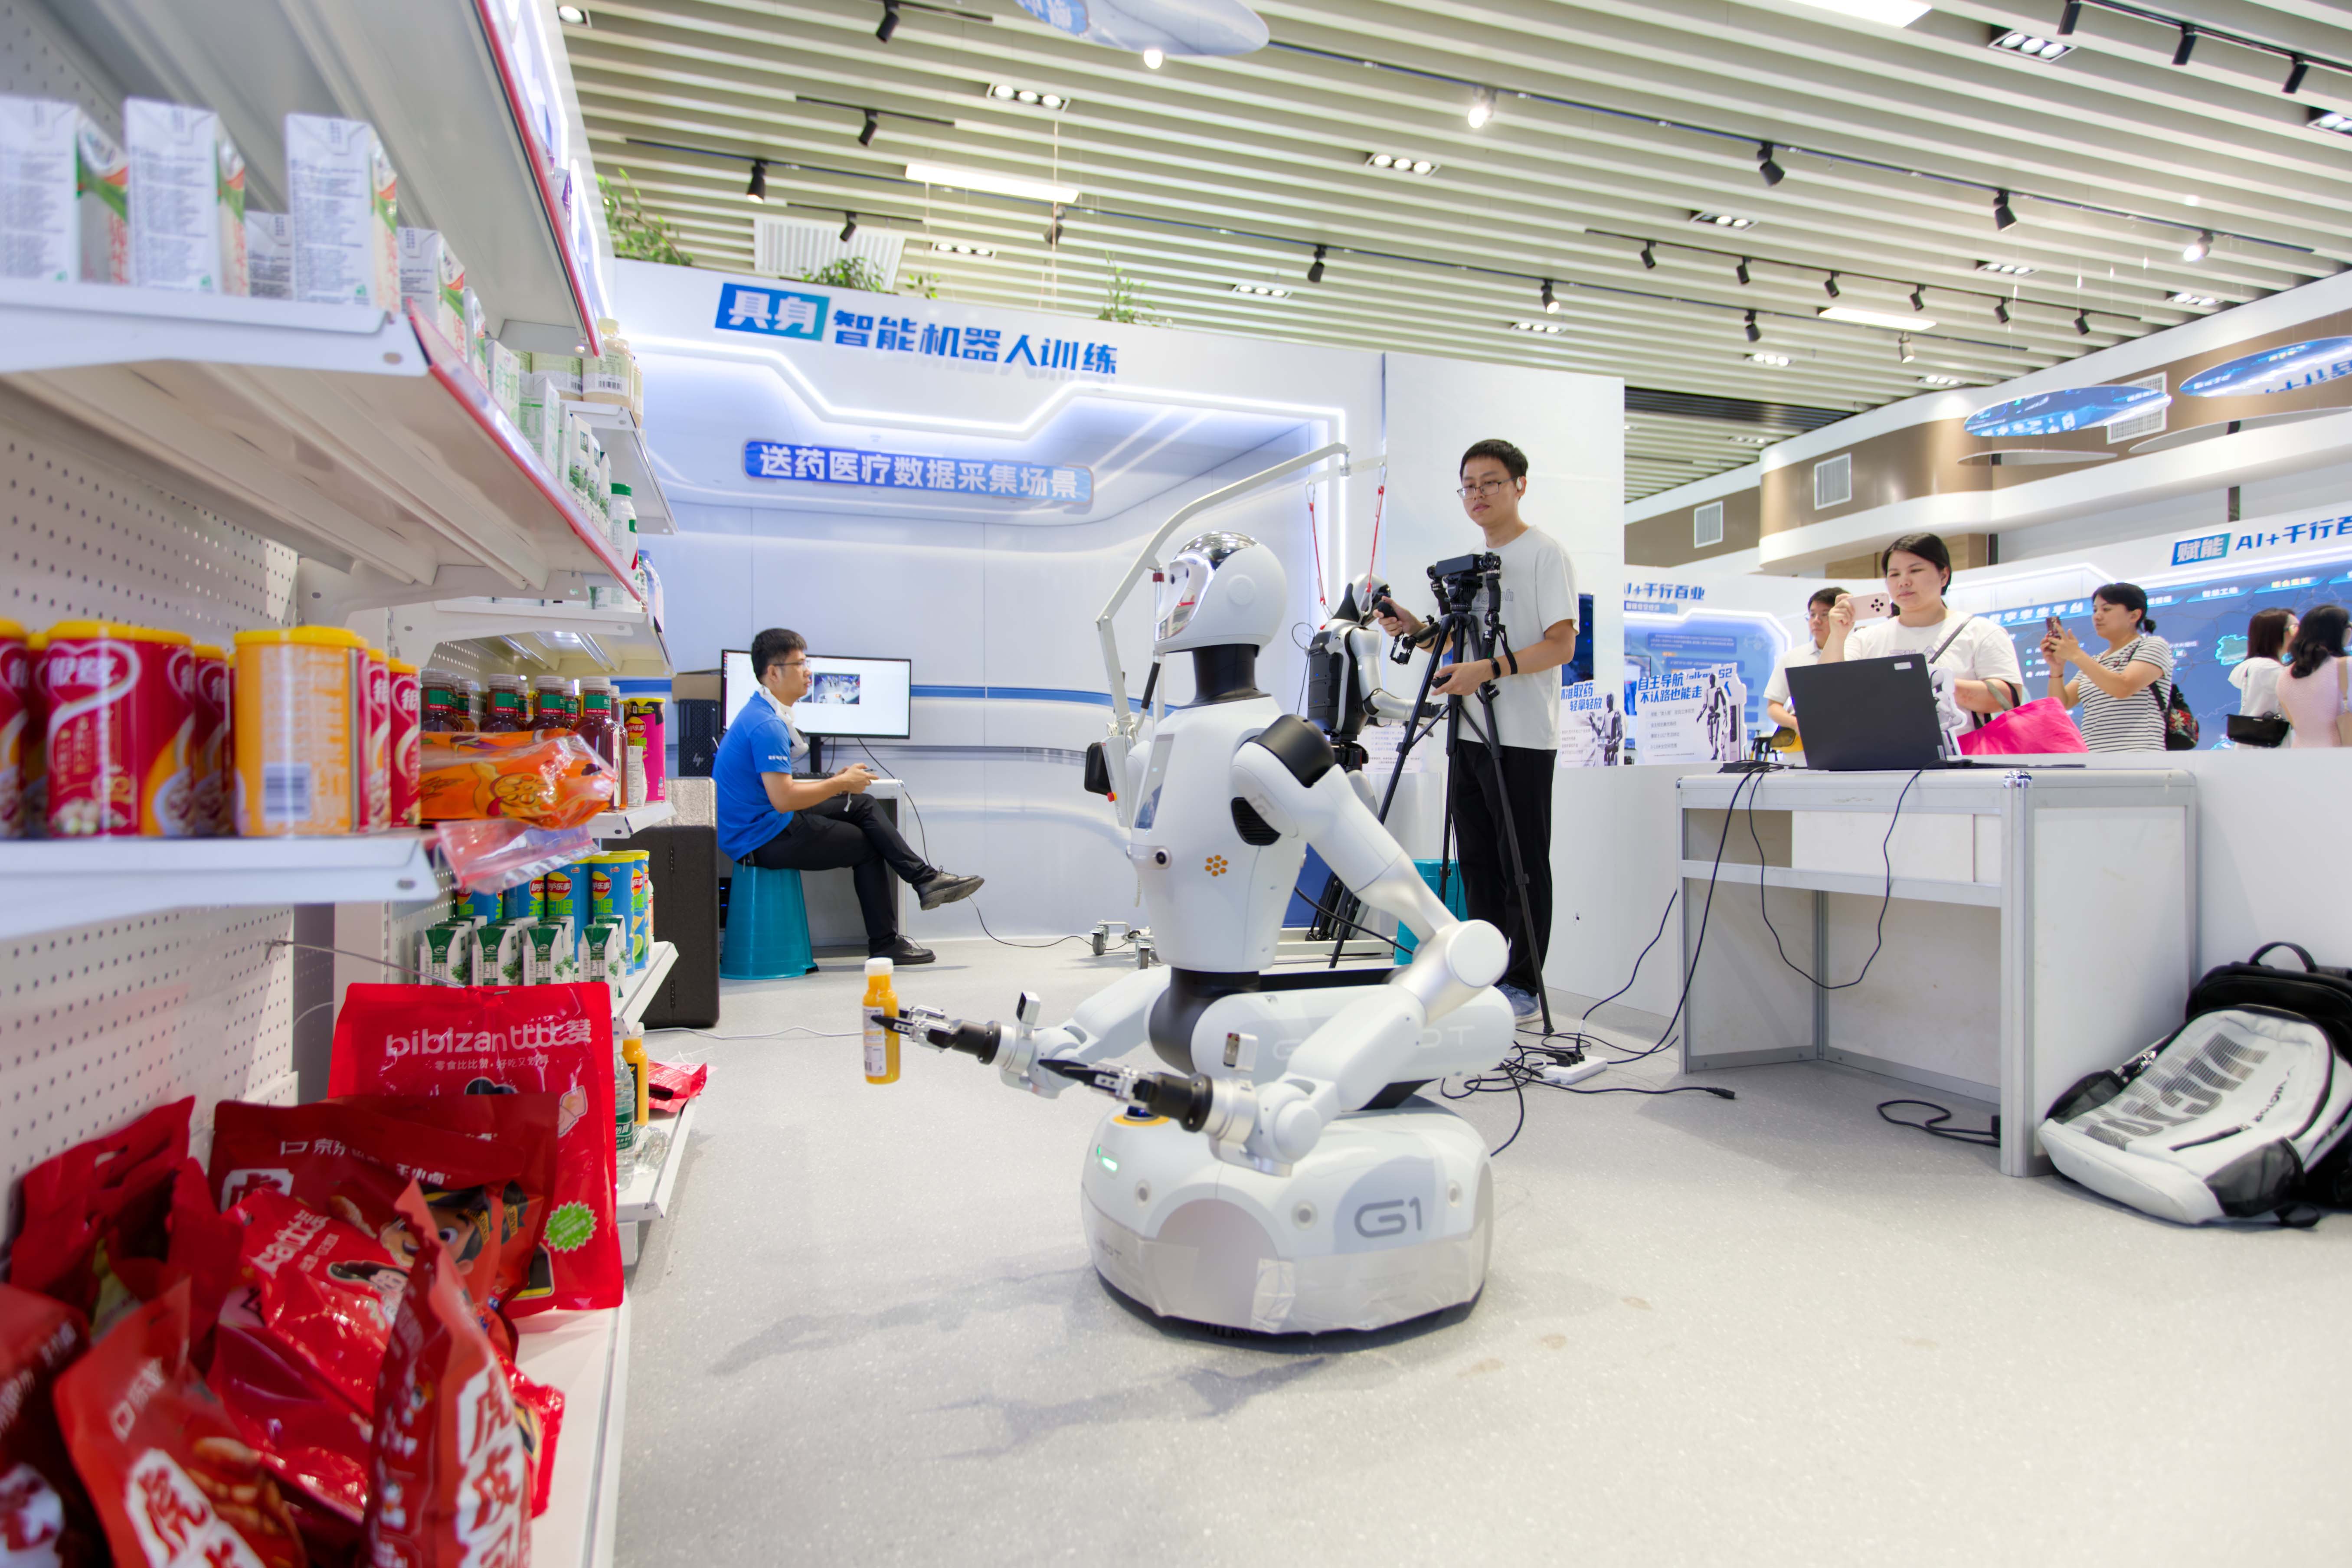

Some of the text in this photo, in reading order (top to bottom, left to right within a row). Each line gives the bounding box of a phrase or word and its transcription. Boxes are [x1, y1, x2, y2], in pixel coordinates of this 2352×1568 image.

[833, 309, 1118, 376] 智能机器人训练
[759, 444, 1078, 499] 送药医疗数据采集场景
[2177, 536, 2225, 563] 赋能
[1624, 583, 1704, 600] I+千行百业
[1638, 672, 1685, 691] 自主导航
[1718, 668, 1732, 678] S2
[1570, 697, 1603, 712] 轻拿轻放
[1640, 685, 1702, 704] 不认路也能走
[386, 1027, 507, 1057] bibizan
[1354, 1196, 1423, 1239] G1
